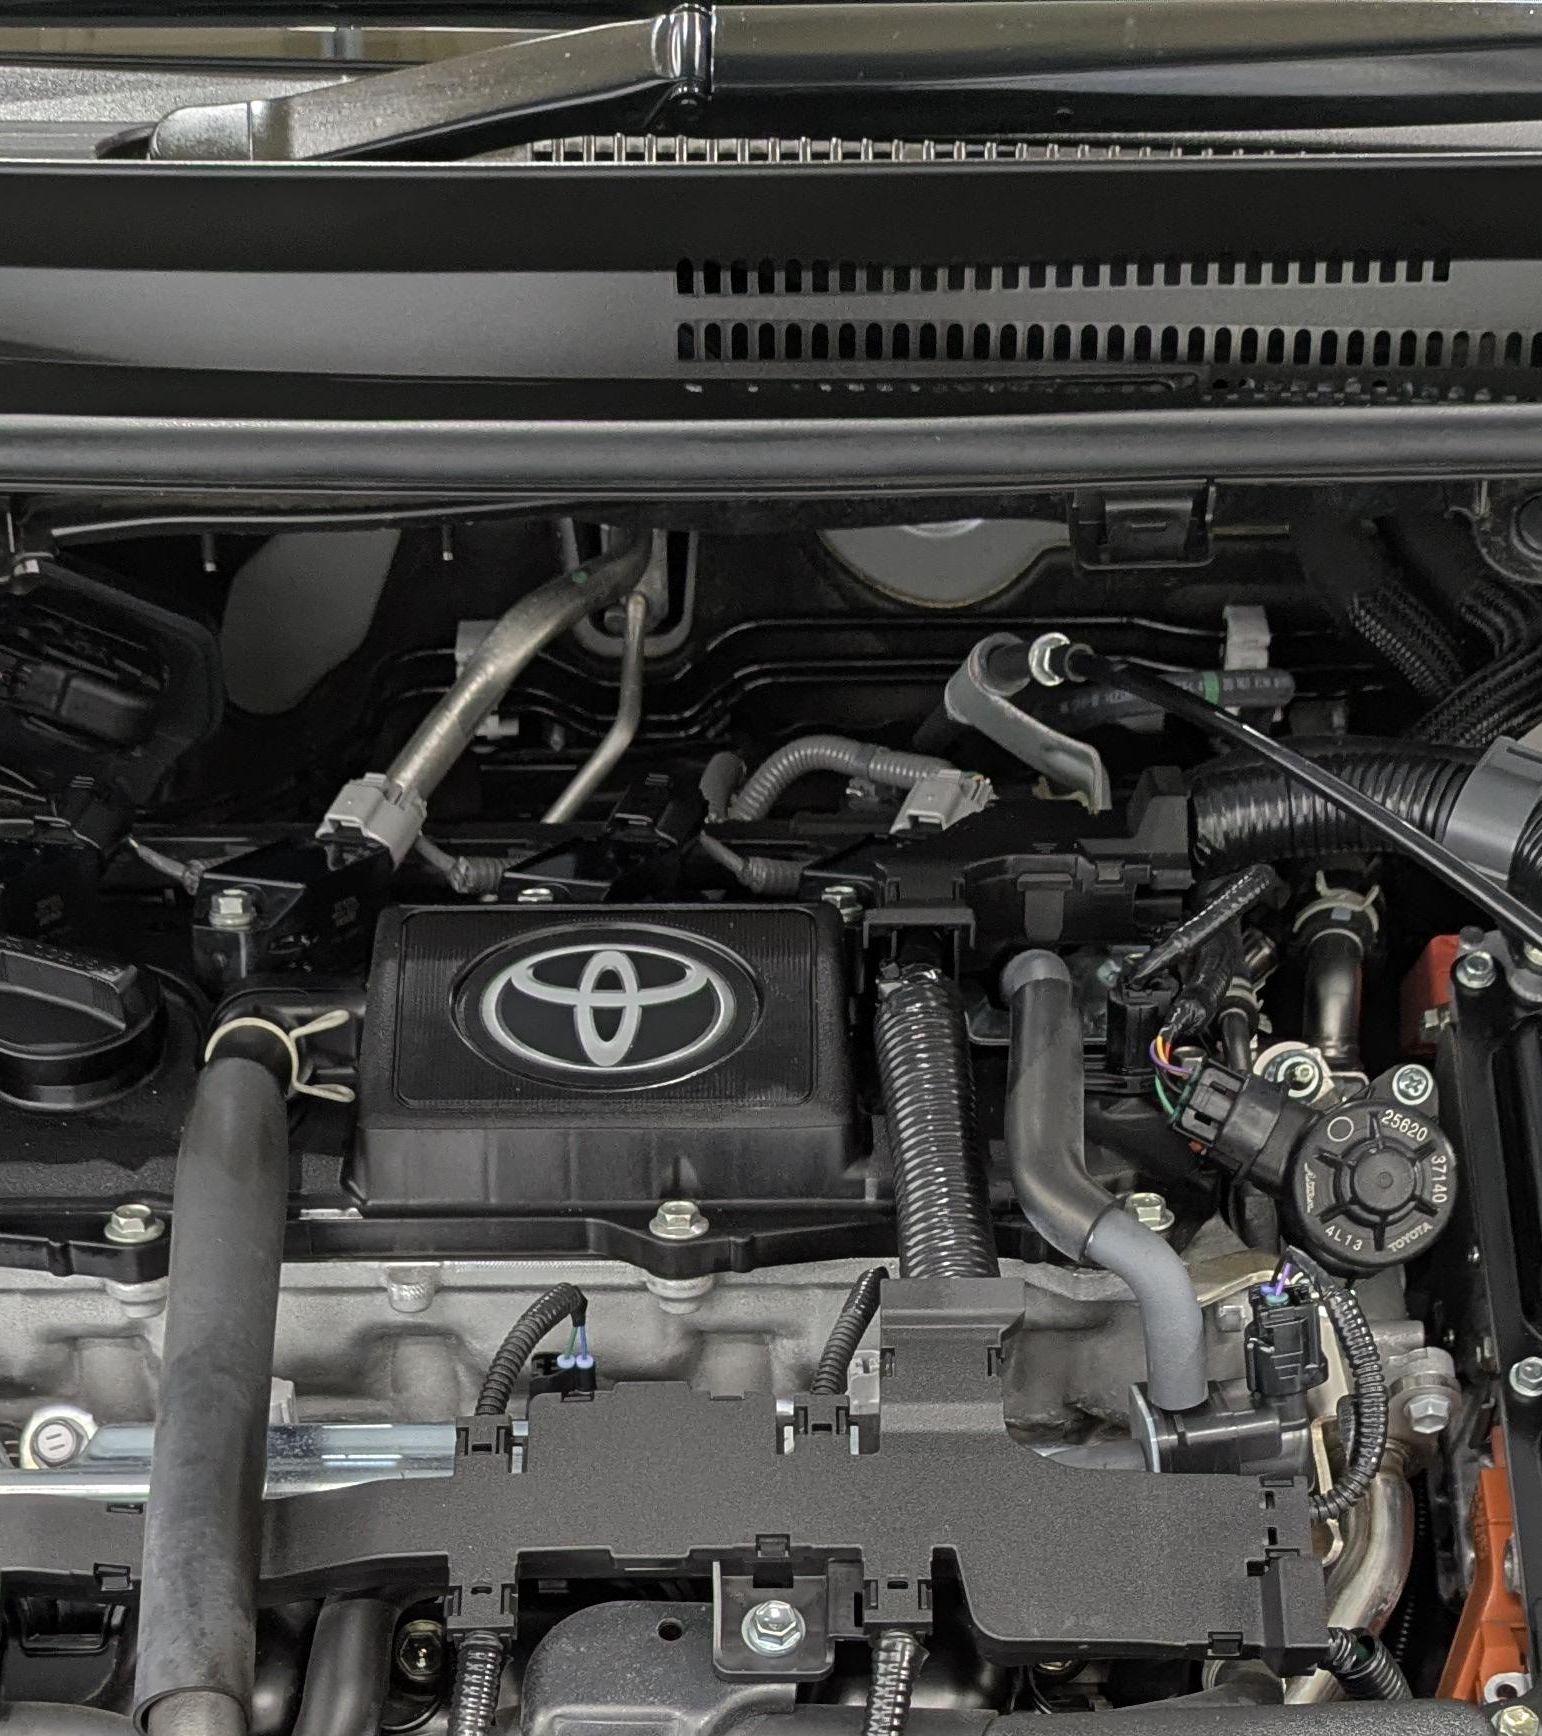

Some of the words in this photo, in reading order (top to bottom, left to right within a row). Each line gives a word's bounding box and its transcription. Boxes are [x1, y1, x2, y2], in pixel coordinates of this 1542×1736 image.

[1381, 1109, 1428, 1142] 25620
[1430, 1155, 1448, 1203] 37140
[1387, 1222, 1434, 1252] TOYOTA
